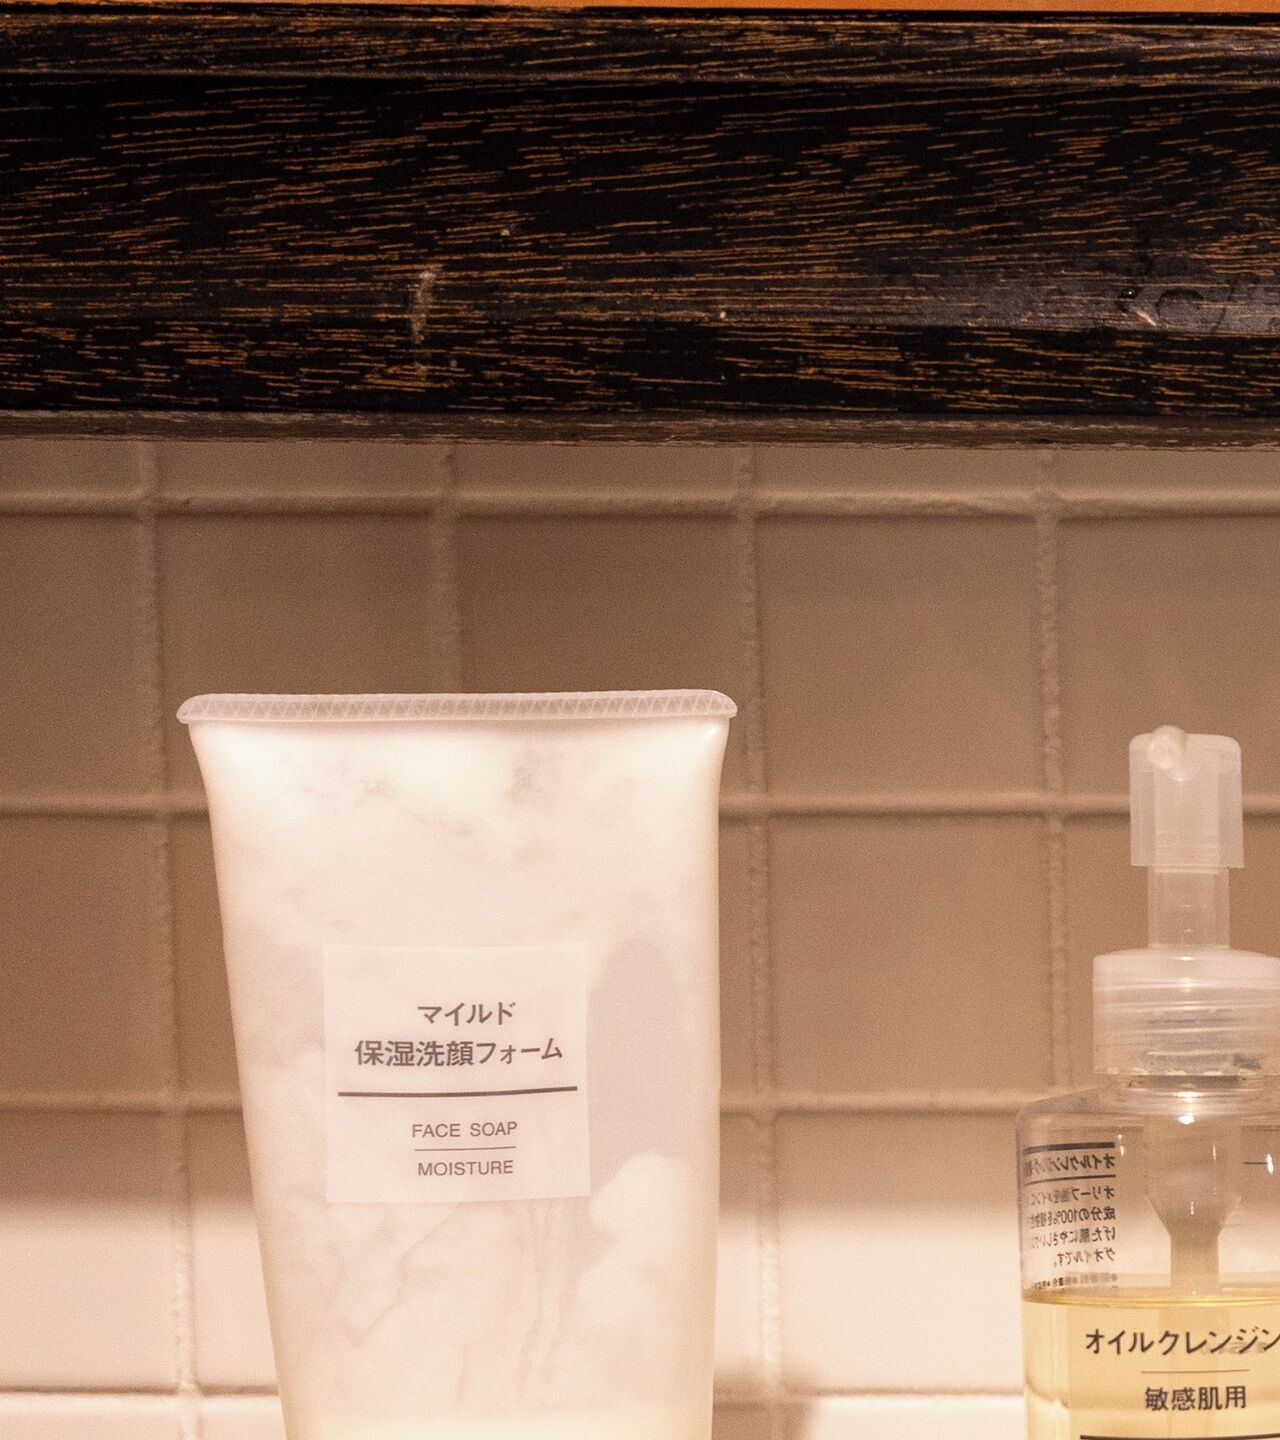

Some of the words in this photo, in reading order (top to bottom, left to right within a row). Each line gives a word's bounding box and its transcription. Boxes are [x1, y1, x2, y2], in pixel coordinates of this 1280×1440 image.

[417, 1001, 517, 1027] マイルド
[354, 1038, 563, 1067] 保湿洗顔フォーム
[411, 1123, 461, 1138] FACE
[470, 1121, 518, 1136] SOAP
[417, 1160, 514, 1176] MOISTURE
[1144, 1385, 1247, 1412] 敏感肌用
